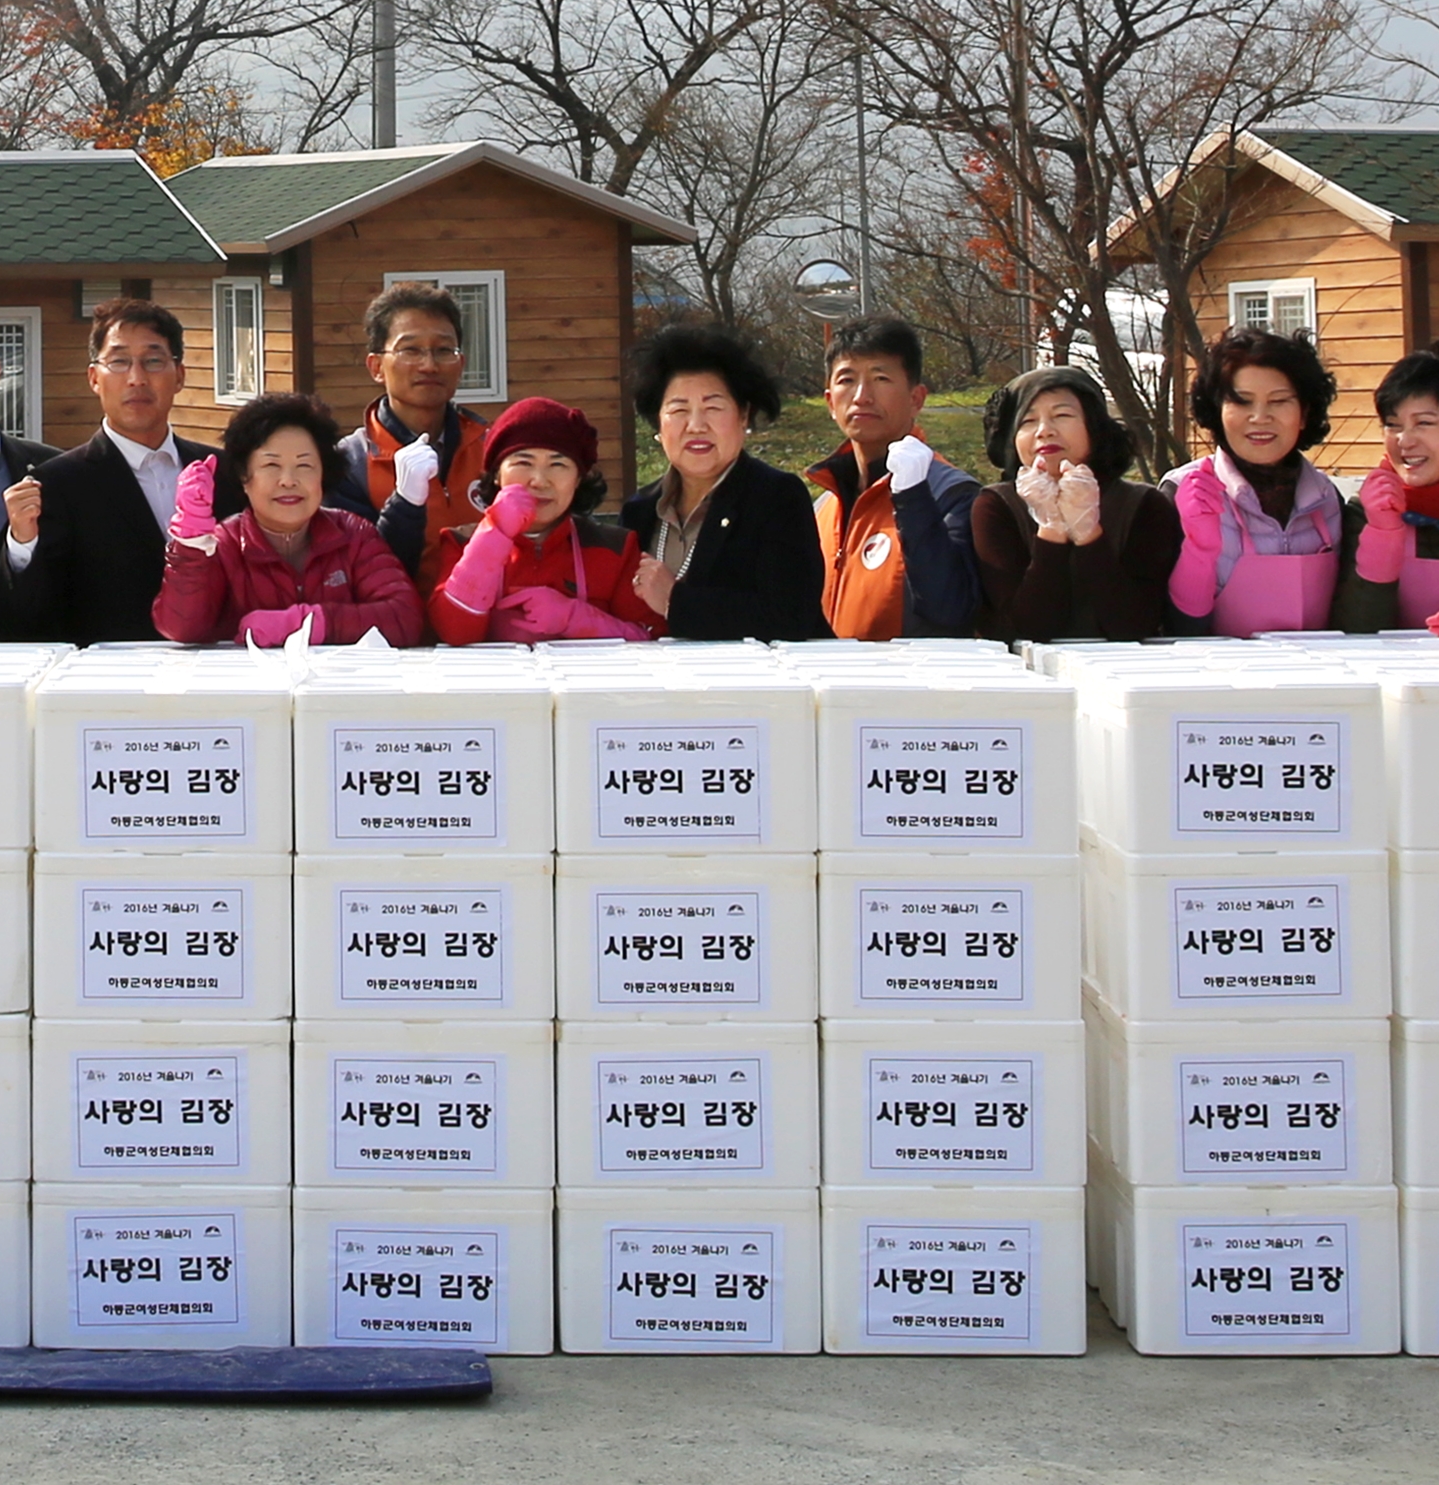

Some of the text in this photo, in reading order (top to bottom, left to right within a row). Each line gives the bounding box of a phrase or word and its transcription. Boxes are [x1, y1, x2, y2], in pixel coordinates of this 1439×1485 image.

[163, 740, 201, 752] 겨울나기
[940, 740, 979, 752] 겨울나기
[91, 768, 241, 796] 사랑의 김장
[867, 768, 1019, 796] 사랑의 김장
[110, 814, 221, 828] 하동군여성단체협의회
[885, 815, 998, 828] 하동군여성단체협의회
[420, 903, 458, 915] 겨울나기
[1256, 899, 1295, 911] 겨울나기
[347, 931, 498, 959] 사랑의 김장
[1183, 927, 1336, 956] 사랑의 김장
[366, 978, 478, 991] 하동군여성단체협의회
[1203, 974, 1317, 989] 하동군여성단체협의회
[156, 1070, 194, 1082] 겨울나기
[950, 1073, 989, 1085] 겨울나기
[84, 1098, 234, 1126] 사랑의 김장
[876, 1101, 1029, 1129] 사랑의 김장
[103, 1145, 215, 1158] 하동군여성단체협의회
[895, 1147, 1008, 1161] 하동군여성단체협의회
[1265, 1238, 1303, 1249] 겨울나기
[416, 1245, 454, 1257] 겨울나기
[342, 1272, 494, 1301] 사랑의 김장
[1191, 1266, 1344, 1294] 사랑의 김장
[360, 1318, 472, 1333] 하동군여성단체협의회
[1210, 1313, 1325, 1327] 하동군여성단체협의회
